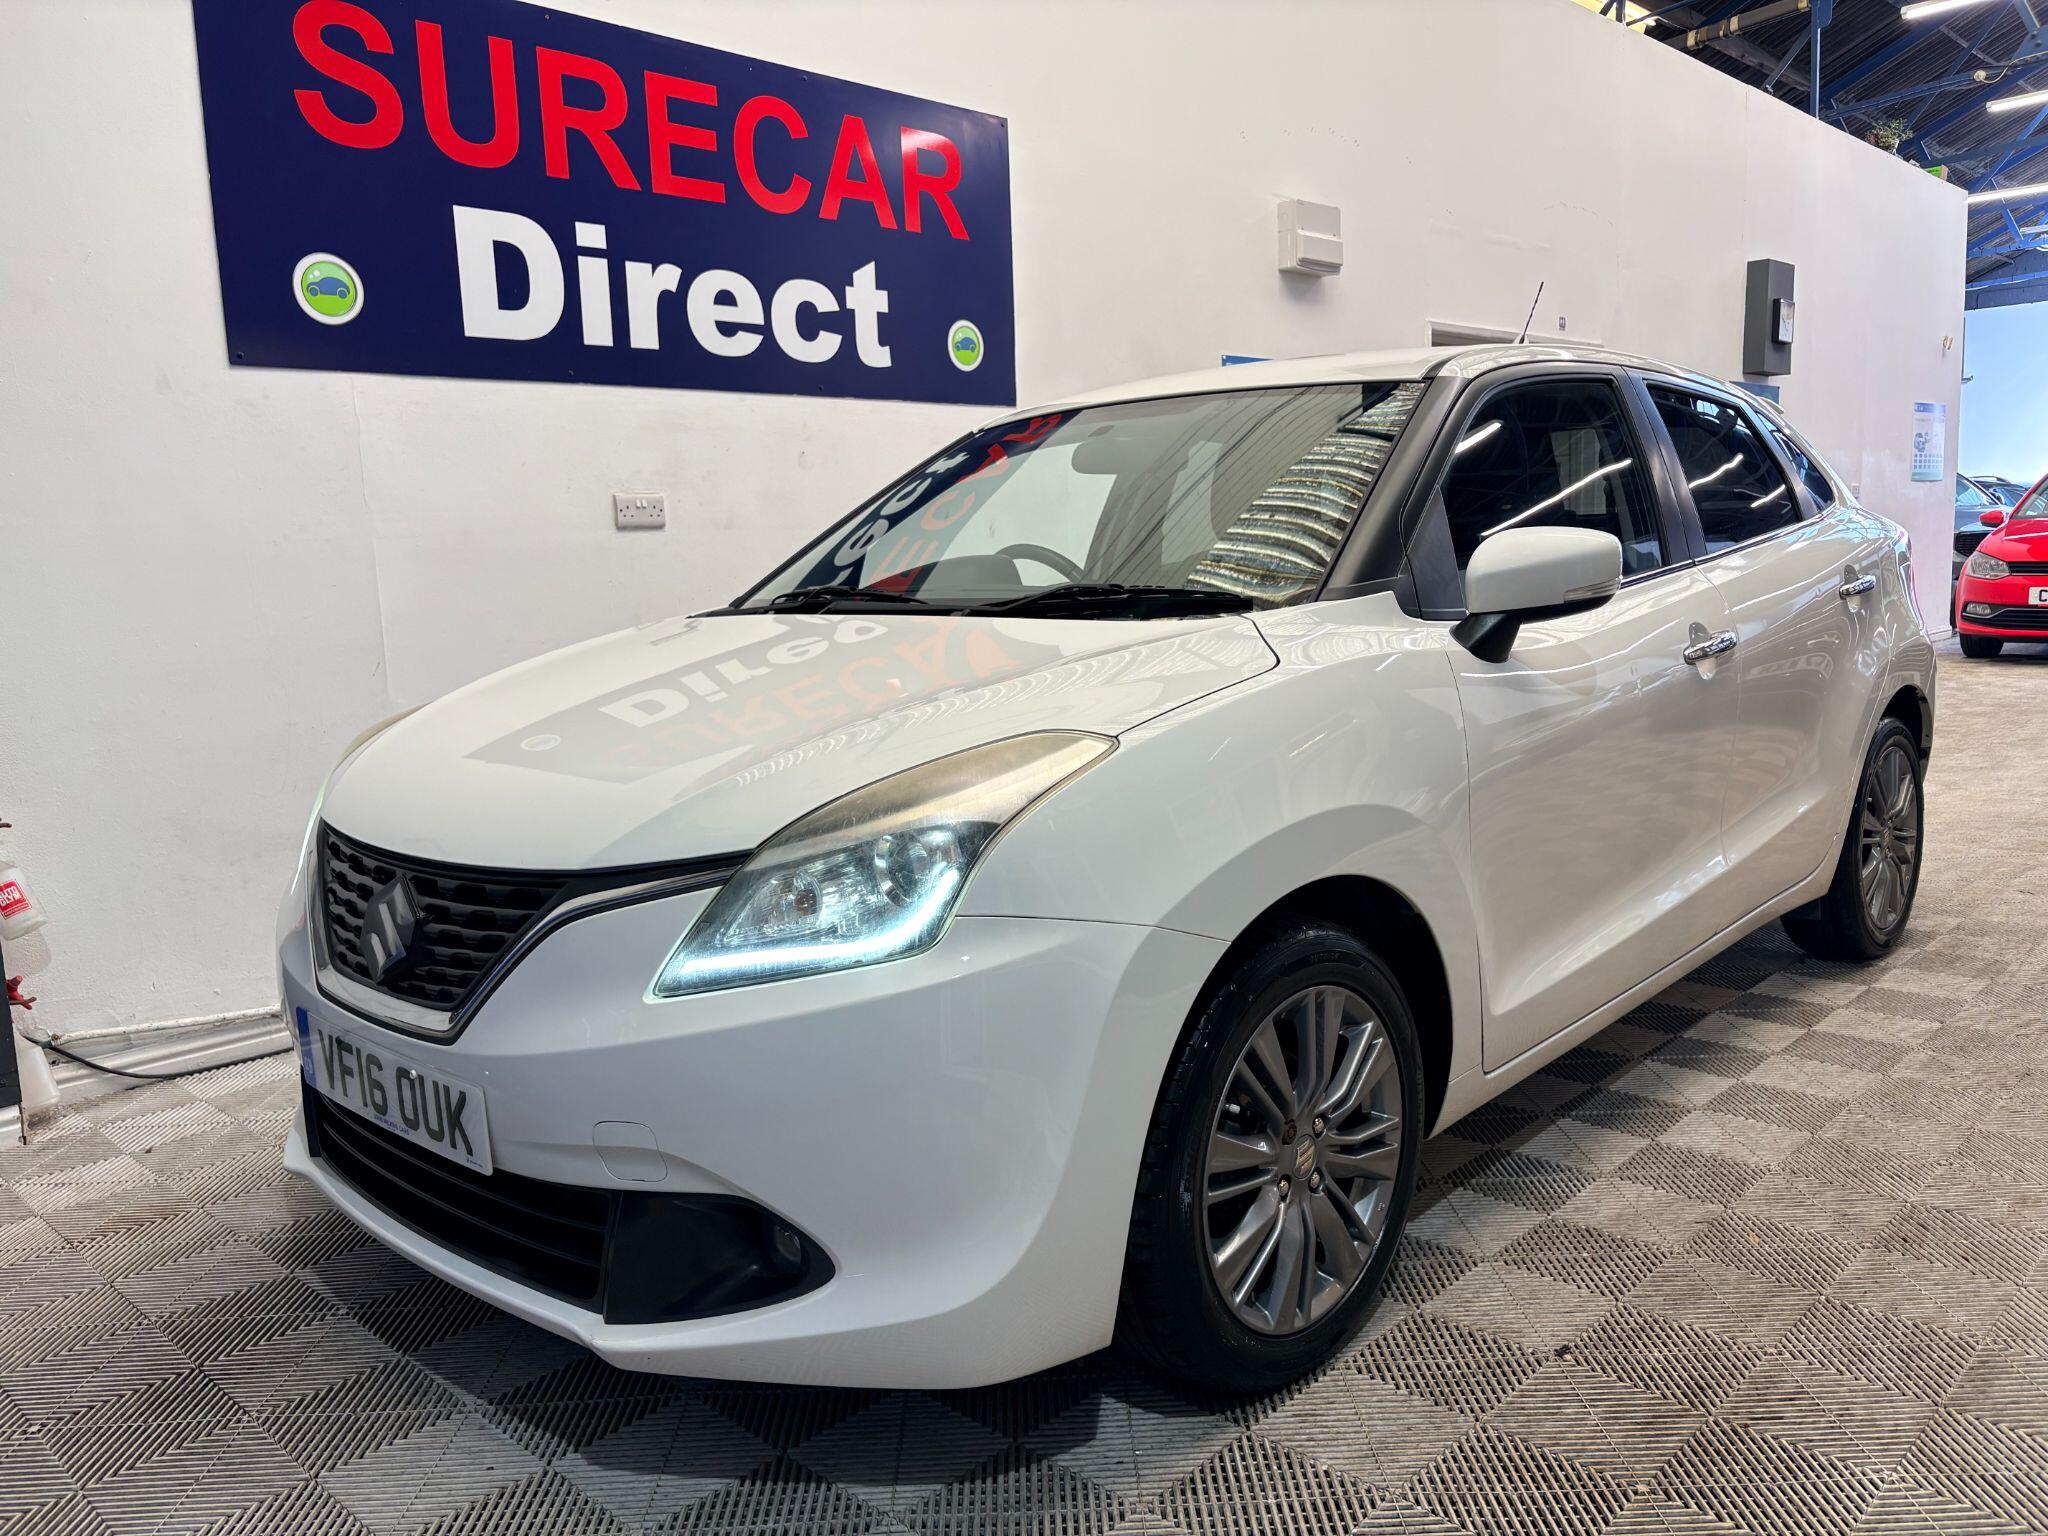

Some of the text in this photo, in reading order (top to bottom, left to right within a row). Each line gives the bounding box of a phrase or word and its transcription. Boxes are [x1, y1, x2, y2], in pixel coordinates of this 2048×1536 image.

[292, 0, 971, 241] SURECAR
[453, 205, 892, 368] Direct
[317, 1029, 473, 1157] VF16 OUK
